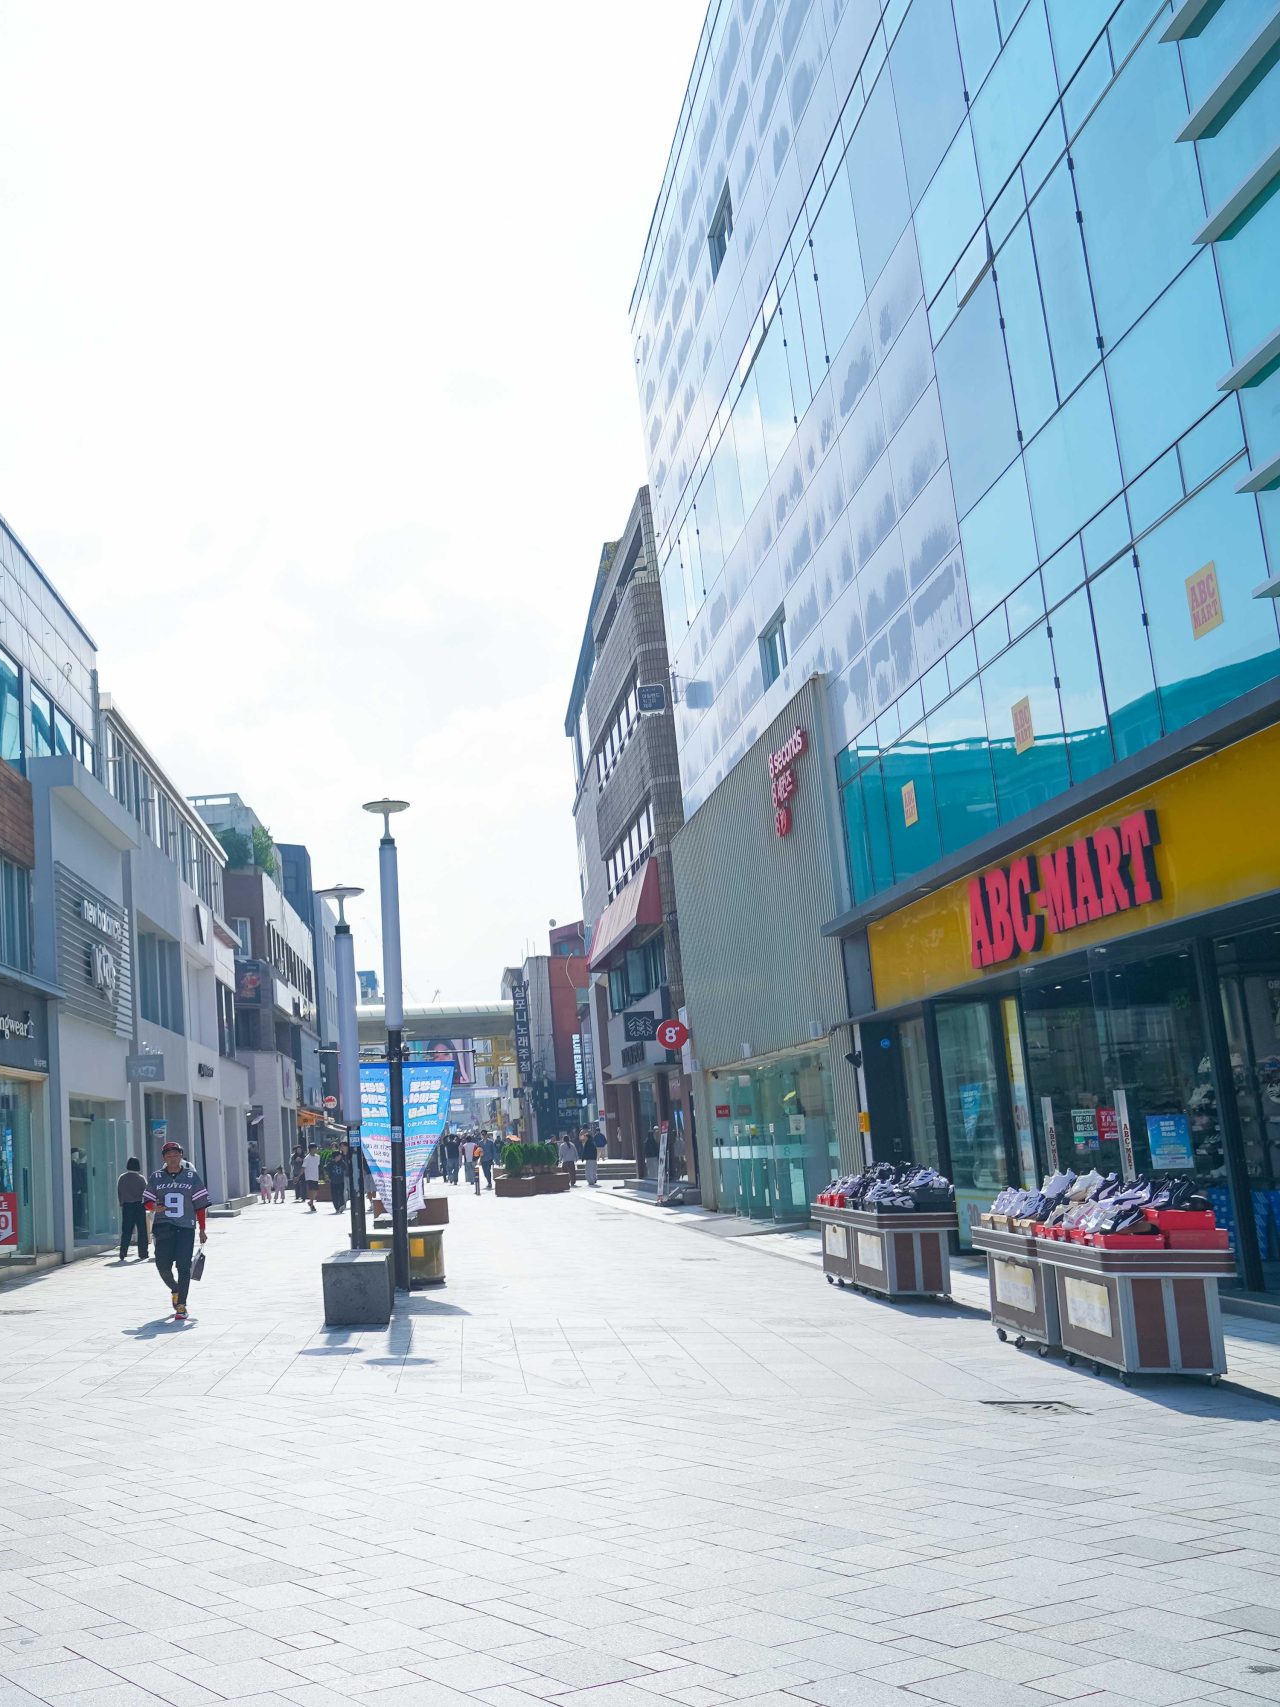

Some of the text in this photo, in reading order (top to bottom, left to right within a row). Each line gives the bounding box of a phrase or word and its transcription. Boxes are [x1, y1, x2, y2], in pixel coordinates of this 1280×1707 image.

[1190, 572, 1216, 609] ABC
[1192, 598, 1218, 630] MART
[966, 809, 1159, 970] ABC-MART
[1122, 1123, 1133, 1170] ABC-MART
[164, 1192, 185, 1218] 9
